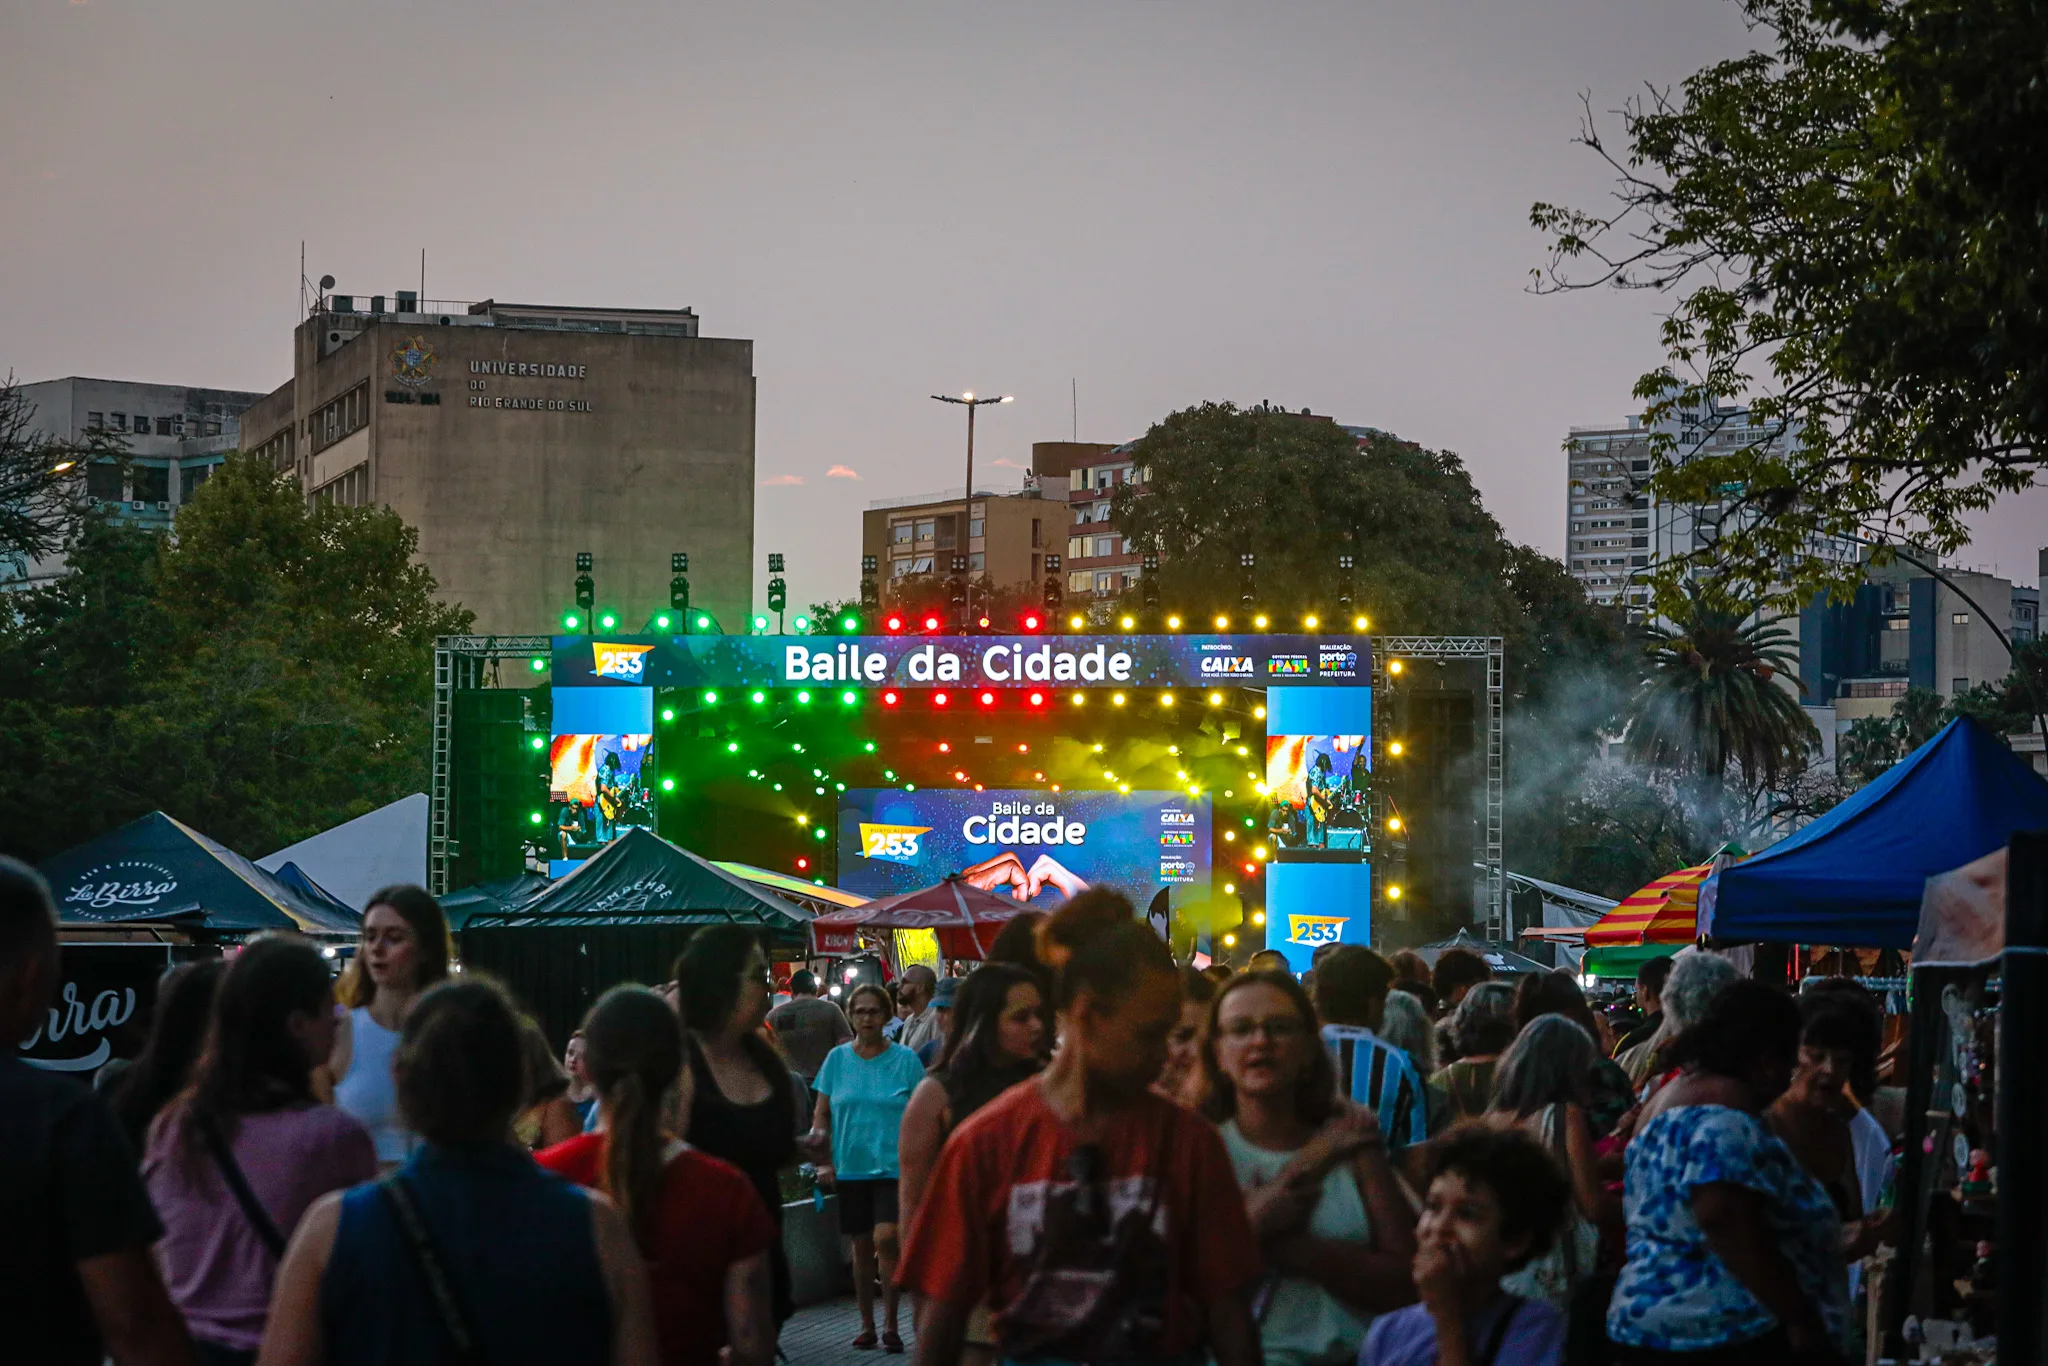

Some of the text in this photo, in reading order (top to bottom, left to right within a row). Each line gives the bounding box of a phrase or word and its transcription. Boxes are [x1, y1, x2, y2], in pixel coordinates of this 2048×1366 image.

[470, 360, 586, 378] UNIVERSIDADE
[470, 380, 486, 391] DO
[470, 396, 592, 412] RIO GRANDE DO SUL
[601, 652, 642, 674] 253
[785, 644, 1133, 682] Baile da Cidade
[1201, 657, 1254, 672] CAIXA
[1320, 652, 1346, 661] porto
[993, 802, 1055, 816] Baile da
[1161, 814, 1194, 822] CAIXA
[963, 815, 1087, 845] Cidade
[869, 833, 918, 856] 253
[1161, 861, 1185, 870] porto
[66, 880, 177, 908] La Birra
[588, 880, 672, 912] AMEMBE
[1297, 923, 1337, 941] 253
